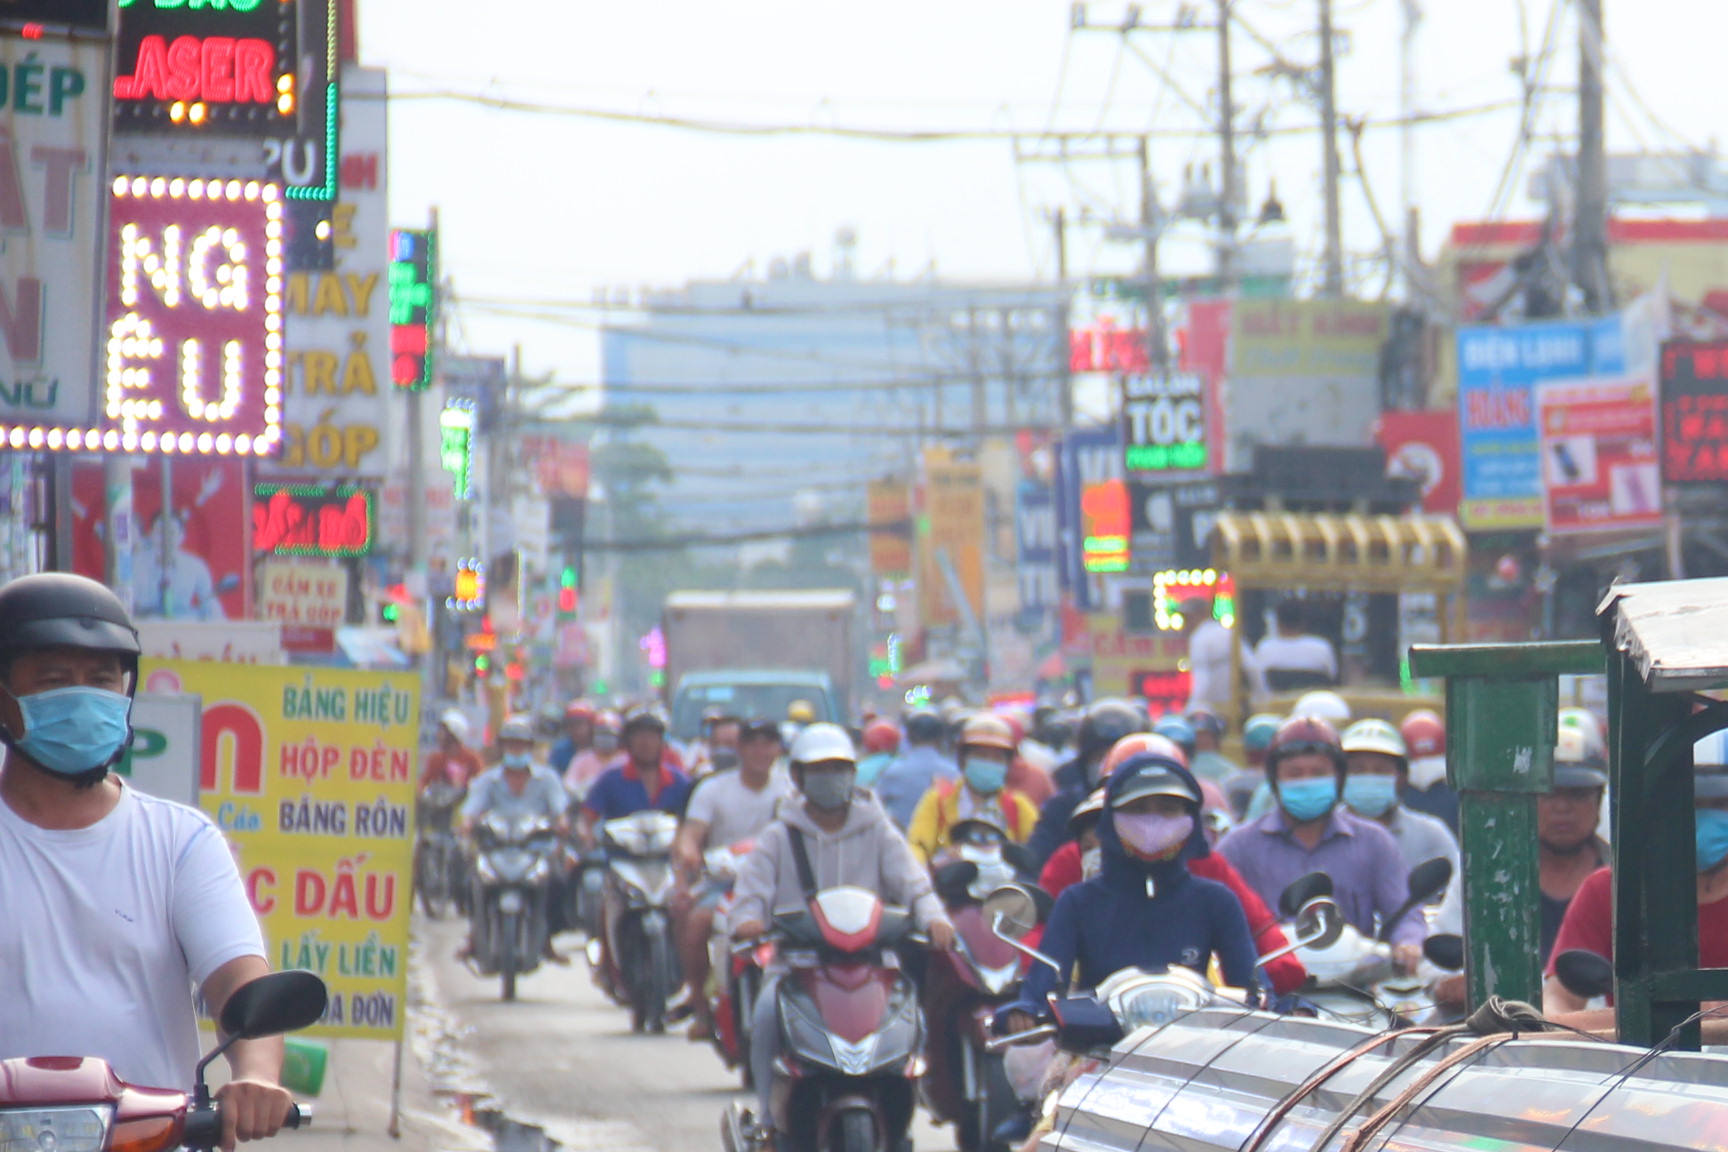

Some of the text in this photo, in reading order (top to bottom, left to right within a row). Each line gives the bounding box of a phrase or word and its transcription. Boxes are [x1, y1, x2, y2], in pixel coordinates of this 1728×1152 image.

[280, 734, 409, 786] HỘP ĐÈN
[294, 852, 394, 921] DẤU
